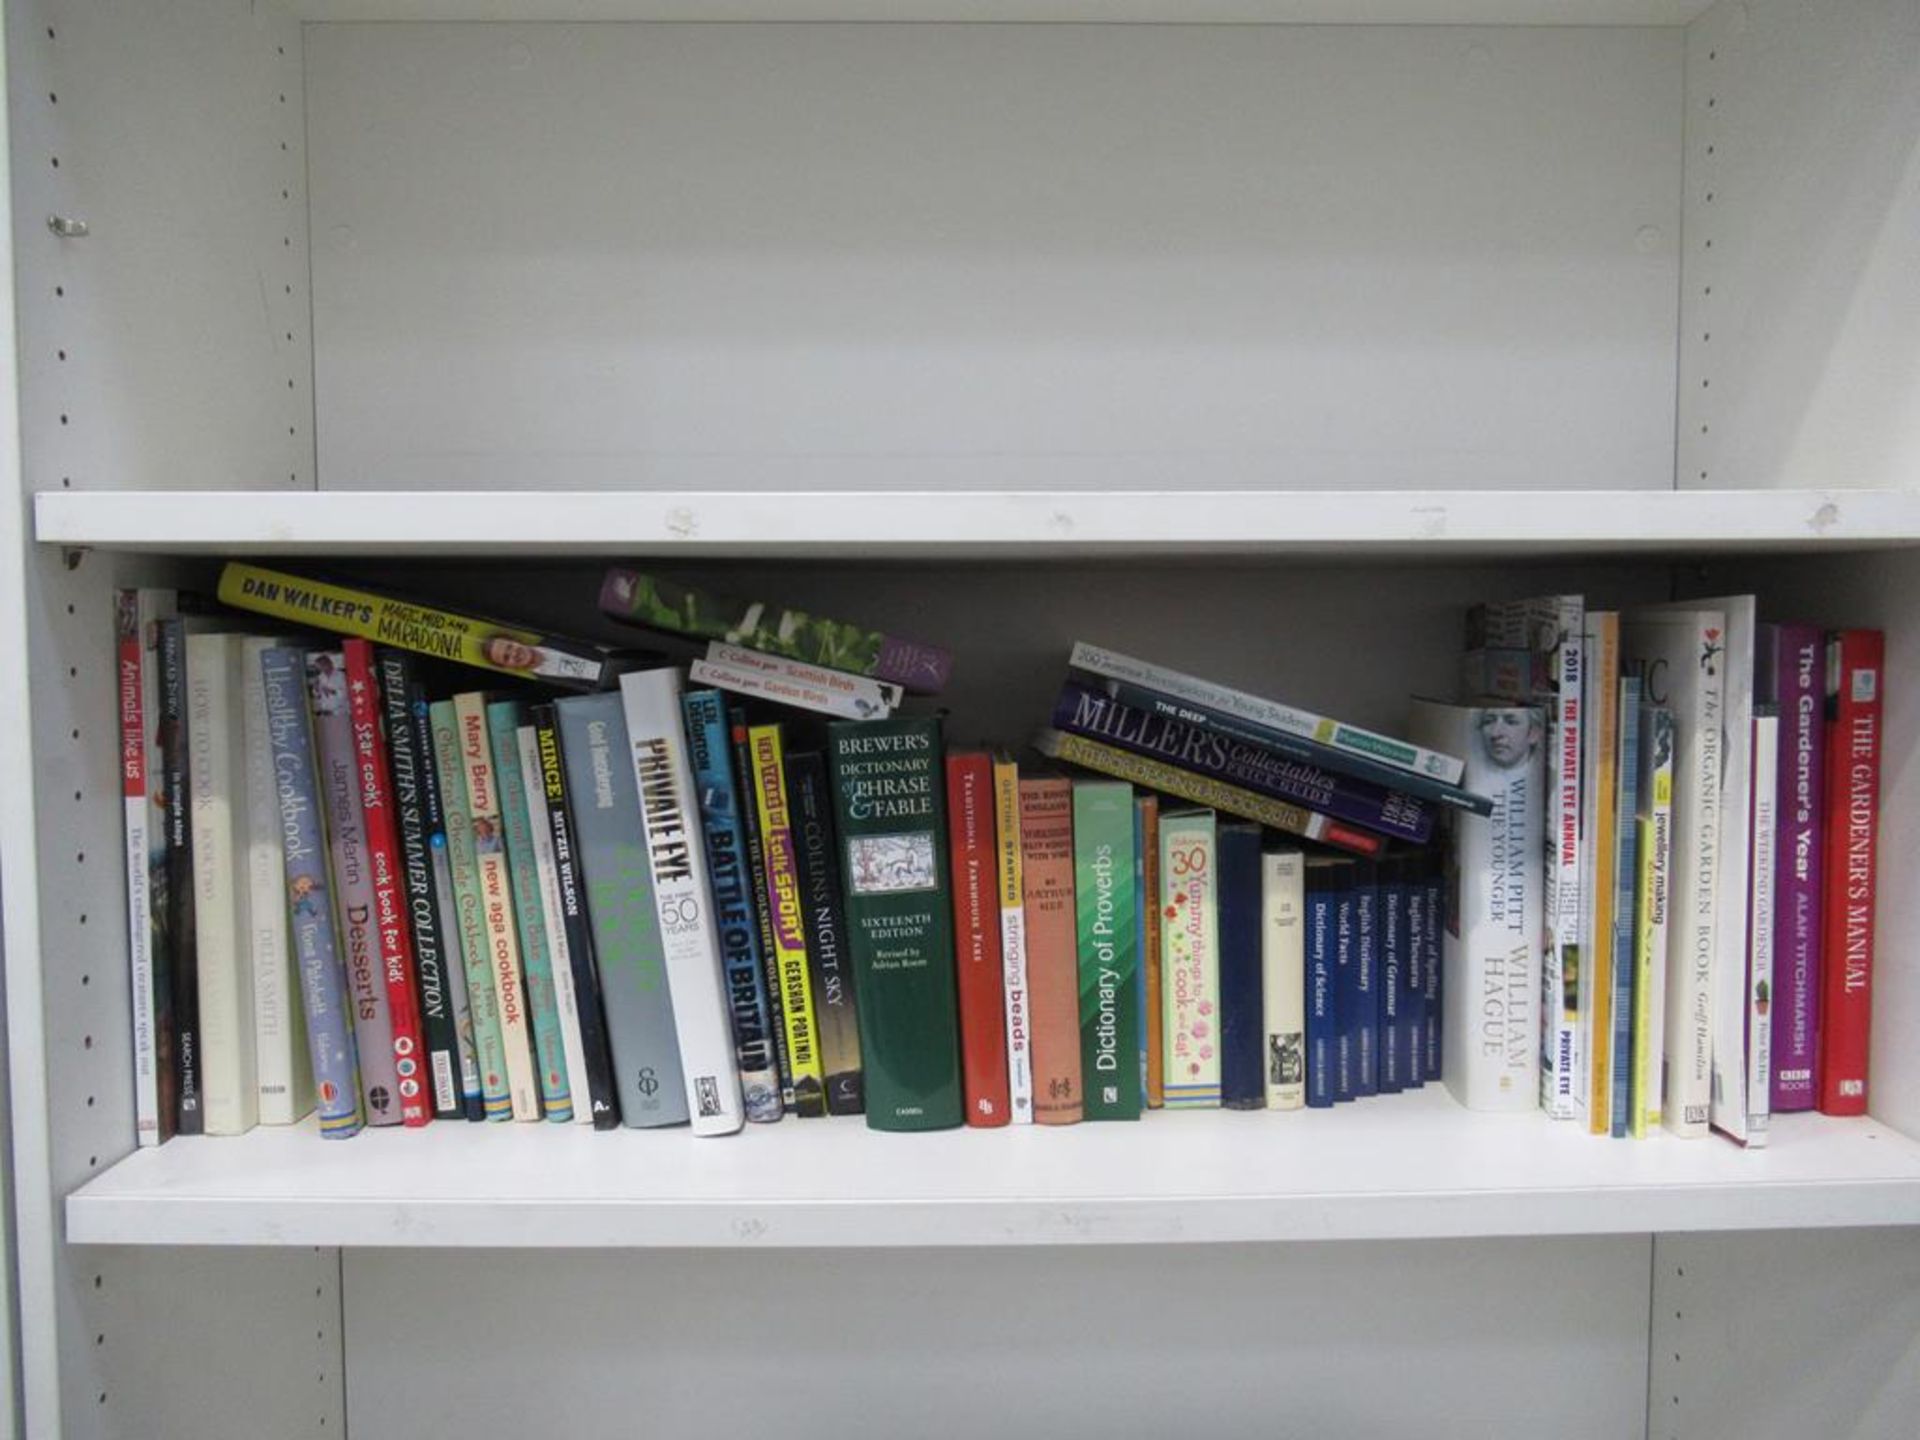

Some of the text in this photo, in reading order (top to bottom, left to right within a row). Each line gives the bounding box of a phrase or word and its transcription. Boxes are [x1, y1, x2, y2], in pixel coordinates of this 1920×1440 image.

[242, 578, 374, 624] DAN WALKER'S
[376, 616, 464, 660] MARADONA
[1564, 649, 1578, 683] 2018
[122, 659, 144, 780] Animals like us
[1072, 692, 1230, 771] MILLER'S
[1154, 700, 1207, 723] THE DEEP
[1564, 698, 1578, 722] THE
[1704, 689, 1719, 720] The
[265, 665, 310, 863] Healthy Cookbook
[354, 721, 382, 809] Star cooks
[464, 714, 489, 812] Mary Berry
[538, 728, 562, 797] MINCE
[838, 733, 930, 755] BREWER'S
[840, 759, 931, 776] DICTIONARY
[1564, 726, 1578, 780] PRIVATE
[1700, 727, 1719, 818] ORGANIC
[1795, 644, 1815, 883] The Gardener's Year
[634, 738, 686, 838] PRIVATE
[850, 793, 934, 820] & FABLE
[856, 776, 932, 797] PHRASE
[1563, 785, 1578, 809] EYE
[331, 759, 361, 886] James Martin
[384, 659, 444, 1019] DELIA SMITH'S SUMMER COLLECTION
[1562, 813, 1578, 867] ANNUAL
[1654, 812, 1669, 872] jewellery
[1843, 714, 1875, 995] THE GARDENER'S MANUAL
[560, 861, 580, 916] WILSON
[651, 841, 692, 885] EYE
[768, 834, 804, 944] talkSPORT
[1005, 840, 1018, 902] STARTED
[1171, 846, 1208, 875] 30
[1490, 791, 1507, 923] THE YOUNGER
[1508, 778, 1526, 936] WILLIAM PITT
[1699, 824, 1717, 915] GARDEN
[375, 851, 405, 984] cook book for kids
[661, 897, 699, 926] 50
[666, 923, 700, 935] YEARS
[861, 914, 932, 929] SIXTEENTH
[870, 926, 924, 939] EDITION
[1186, 871, 1208, 938] Yummy
[1313, 902, 1327, 961] Dictionary
[1339, 901, 1350, 936] World
[1652, 876, 1667, 925] making
[345, 904, 380, 1021] Desserts
[484, 858, 520, 1026] new aga cookbook
[710, 829, 770, 1074] BATTLE OF BRITAIN
[814, 905, 840, 971] NIGHT
[1091, 844, 1120, 1071] Dictionary of Proverbs
[1314, 962, 1327, 976] of
[1385, 893, 1399, 1017] Dictionary of Grammar
[1696, 925, 1712, 985] BOOK
[784, 960, 807, 1013] GERSHON
[824, 975, 844, 1007] SKY
[1004, 914, 1028, 1052] stringing beads
[1793, 890, 1809, 1057] ALAN TITCHMARSH
[262, 981, 281, 1036] SMITH
[1174, 968, 1195, 1057] cook eat
[1483, 956, 1505, 1057] HAGUE
[1506, 944, 1529, 1070] WILLIAM
[181, 1031, 197, 1096] SEARCH PRESS
[1559, 1030, 1573, 1096] PRIVATE EYE
